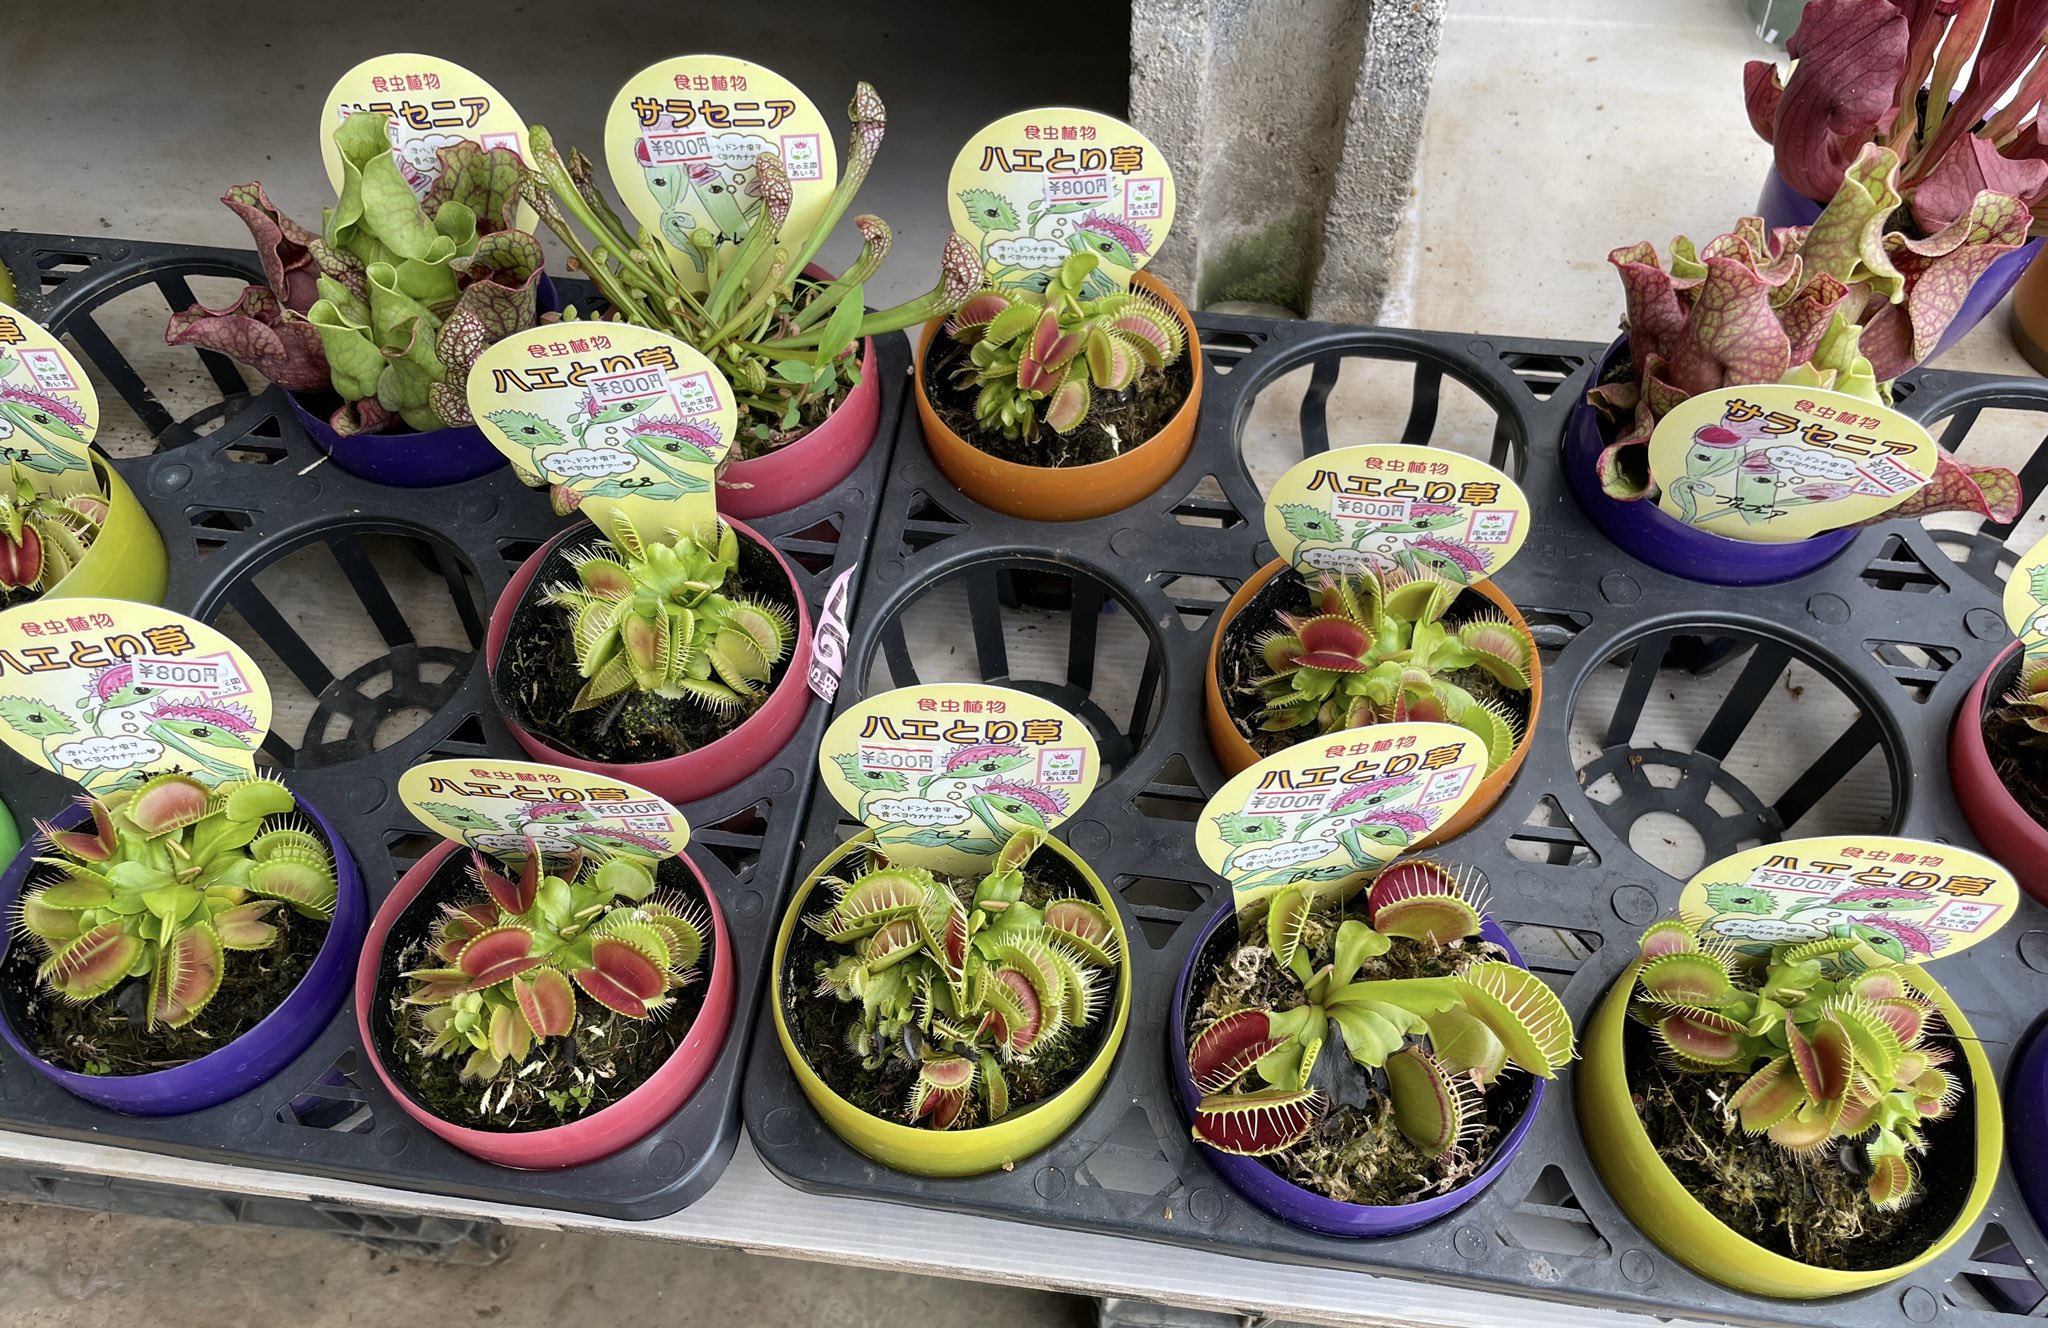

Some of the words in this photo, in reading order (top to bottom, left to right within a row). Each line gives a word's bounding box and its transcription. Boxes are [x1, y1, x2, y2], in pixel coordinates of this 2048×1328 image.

[372, 73, 441, 92] 食虫植物
[674, 75, 747, 91] 食虫植物
[341, 97, 490, 130] ラセニア
[632, 97, 796, 129] サラセニア
[1024, 125, 1097, 140] 食虫植物
[652, 136, 710, 157] ¥800円
[787, 161, 817, 170] 花の王国
[980, 146, 1143, 174] ハエとり草
[792, 169, 816, 177] あいち
[1049, 178, 1107, 195] ¥800円
[1129, 203, 1158, 211] 花の王国
[527, 335, 612, 359] 食虫植物
[492, 346, 679, 393] ハエとり草
[594, 374, 663, 396] ¥800円
[680, 396, 713, 409] 花の王国
[687, 403, 714, 414] あいち
[1794, 399, 1881, 430] 食虫植物
[1725, 399, 1917, 458] サラセニア
[1364, 457, 1449, 474] 食虫植物
[1866, 459, 1917, 489] ¥800円
[1307, 470, 1500, 506] ハエとり草
[1338, 500, 1405, 517] ¥800円
[21, 613, 115, 637] 食虫植物
[0, 625, 195, 676] ハエとり草
[139, 662, 218, 683] ¥800円
[917, 699, 1006, 714] 食虫植物
[860, 716, 1063, 744] ハエとり草
[1325, 736, 1417, 758] 食虫植物
[862, 750, 933, 769] ¥800円
[1256, 742, 1466, 790] ハエとり草
[469, 769, 561, 784] 食虫植物
[1042, 769, 1078, 777] 花の王国
[429, 777, 630, 803] ハエとり草
[590, 802, 664, 814] ¥800円
[1251, 793, 1326, 809] ¥800円
[1840, 846, 1944, 868] 食虫植物
[1752, 855, 1996, 897] ハエとり草
[1759, 872, 1842, 891] ¥800円
